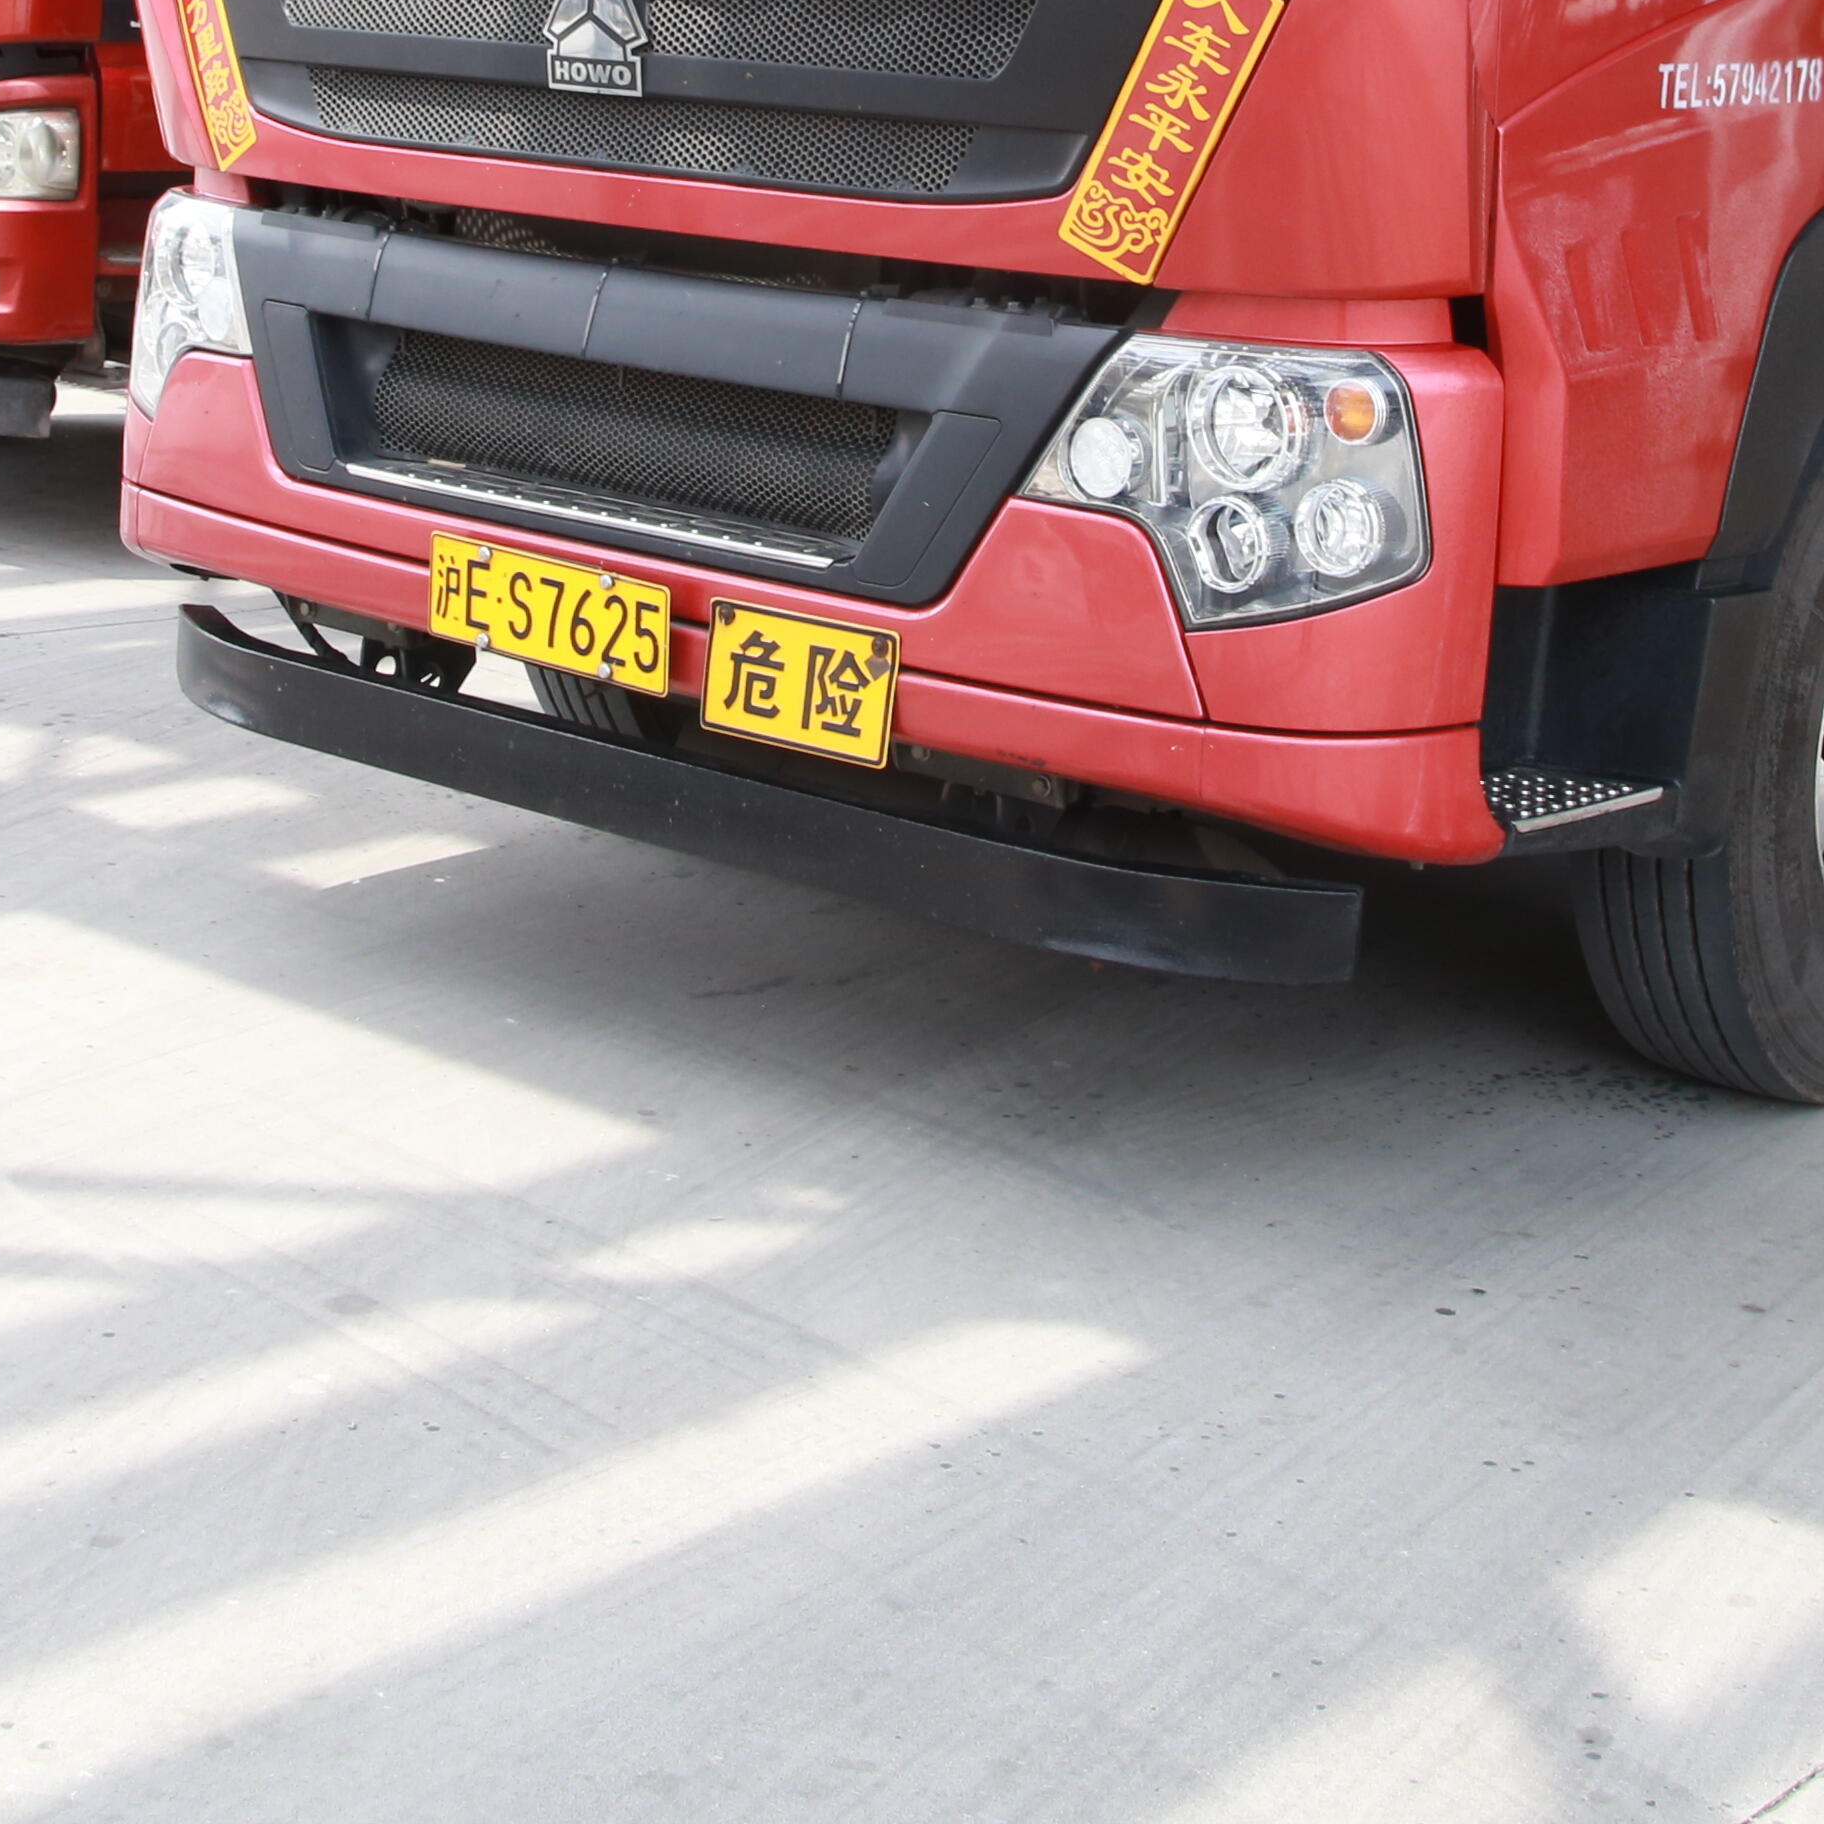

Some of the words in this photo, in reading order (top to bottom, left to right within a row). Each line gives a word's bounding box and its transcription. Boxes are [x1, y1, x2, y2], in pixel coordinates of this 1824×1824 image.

[554, 60, 632, 86] HOWO
[1658, 57, 1824, 110] TEL:57942178
[723, 630, 869, 738] 危险
